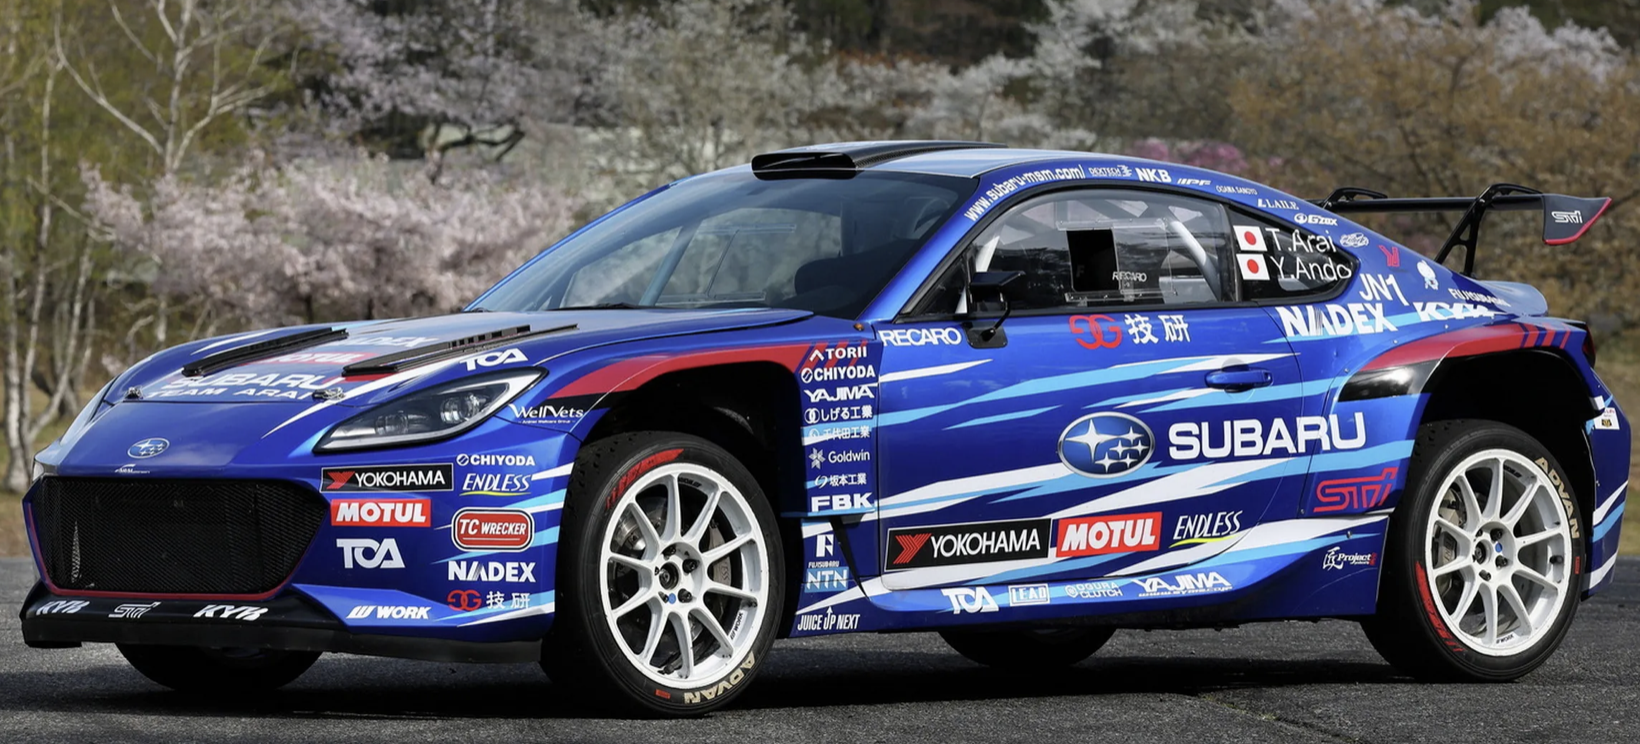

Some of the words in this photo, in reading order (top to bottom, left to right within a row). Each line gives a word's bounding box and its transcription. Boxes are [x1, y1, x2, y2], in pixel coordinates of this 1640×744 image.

[1135, 167, 1172, 183] NKB
[1265, 228, 1337, 253] T.Arai
[1270, 256, 1352, 281] Y.Ando
[1359, 273, 1410, 306] JN1
[1275, 302, 1398, 337] NADEX
[879, 327, 962, 347] RECARO
[1125, 313, 1190, 345] 技研
[825, 346, 867, 360] TORII
[161, 373, 346, 391] SUBARU
[814, 365, 875, 382] CHIYODA
[143, 388, 226, 399] TEAM
[235, 388, 315, 400] ARAI
[804, 385, 875, 403] YAJIMA
[508, 403, 584, 418] WellNets
[821, 404, 872, 421] しげる工業
[1168, 411, 1367, 460] SUBARU
[469, 455, 535, 466] CHIYODA
[828, 449, 870, 464] Goldwin
[355, 470, 446, 488] YOKOHAMA
[462, 473, 533, 491] ENDLESS
[811, 492, 873, 513] FBK
[1534, 456, 1580, 539] ADVAN
[336, 502, 427, 523] MOTUL
[459, 519, 479, 535] TC
[481, 522, 527, 536] WRECKER
[1061, 518, 1157, 551] MOTUL
[1173, 511, 1244, 541] ENDLESS
[931, 528, 1042, 558] YOKOHAMA
[1337, 552, 1371, 565] Project
[448, 560, 536, 582] NADEX
[806, 569, 848, 590] NTN
[1076, 581, 1119, 591] OGURA
[1131, 571, 1232, 592] YAJIMA
[486, 591, 531, 610] 技研
[1012, 587, 1047, 602] LEAD
[1079, 588, 1123, 599] CLUTCH
[36, 600, 90, 616] KYB
[193, 604, 269, 621] KYB
[376, 605, 432, 619] WORK
[797, 614, 823, 631] JUICE
[836, 614, 860, 630] NEXT
[684, 650, 756, 704] ADVAN
